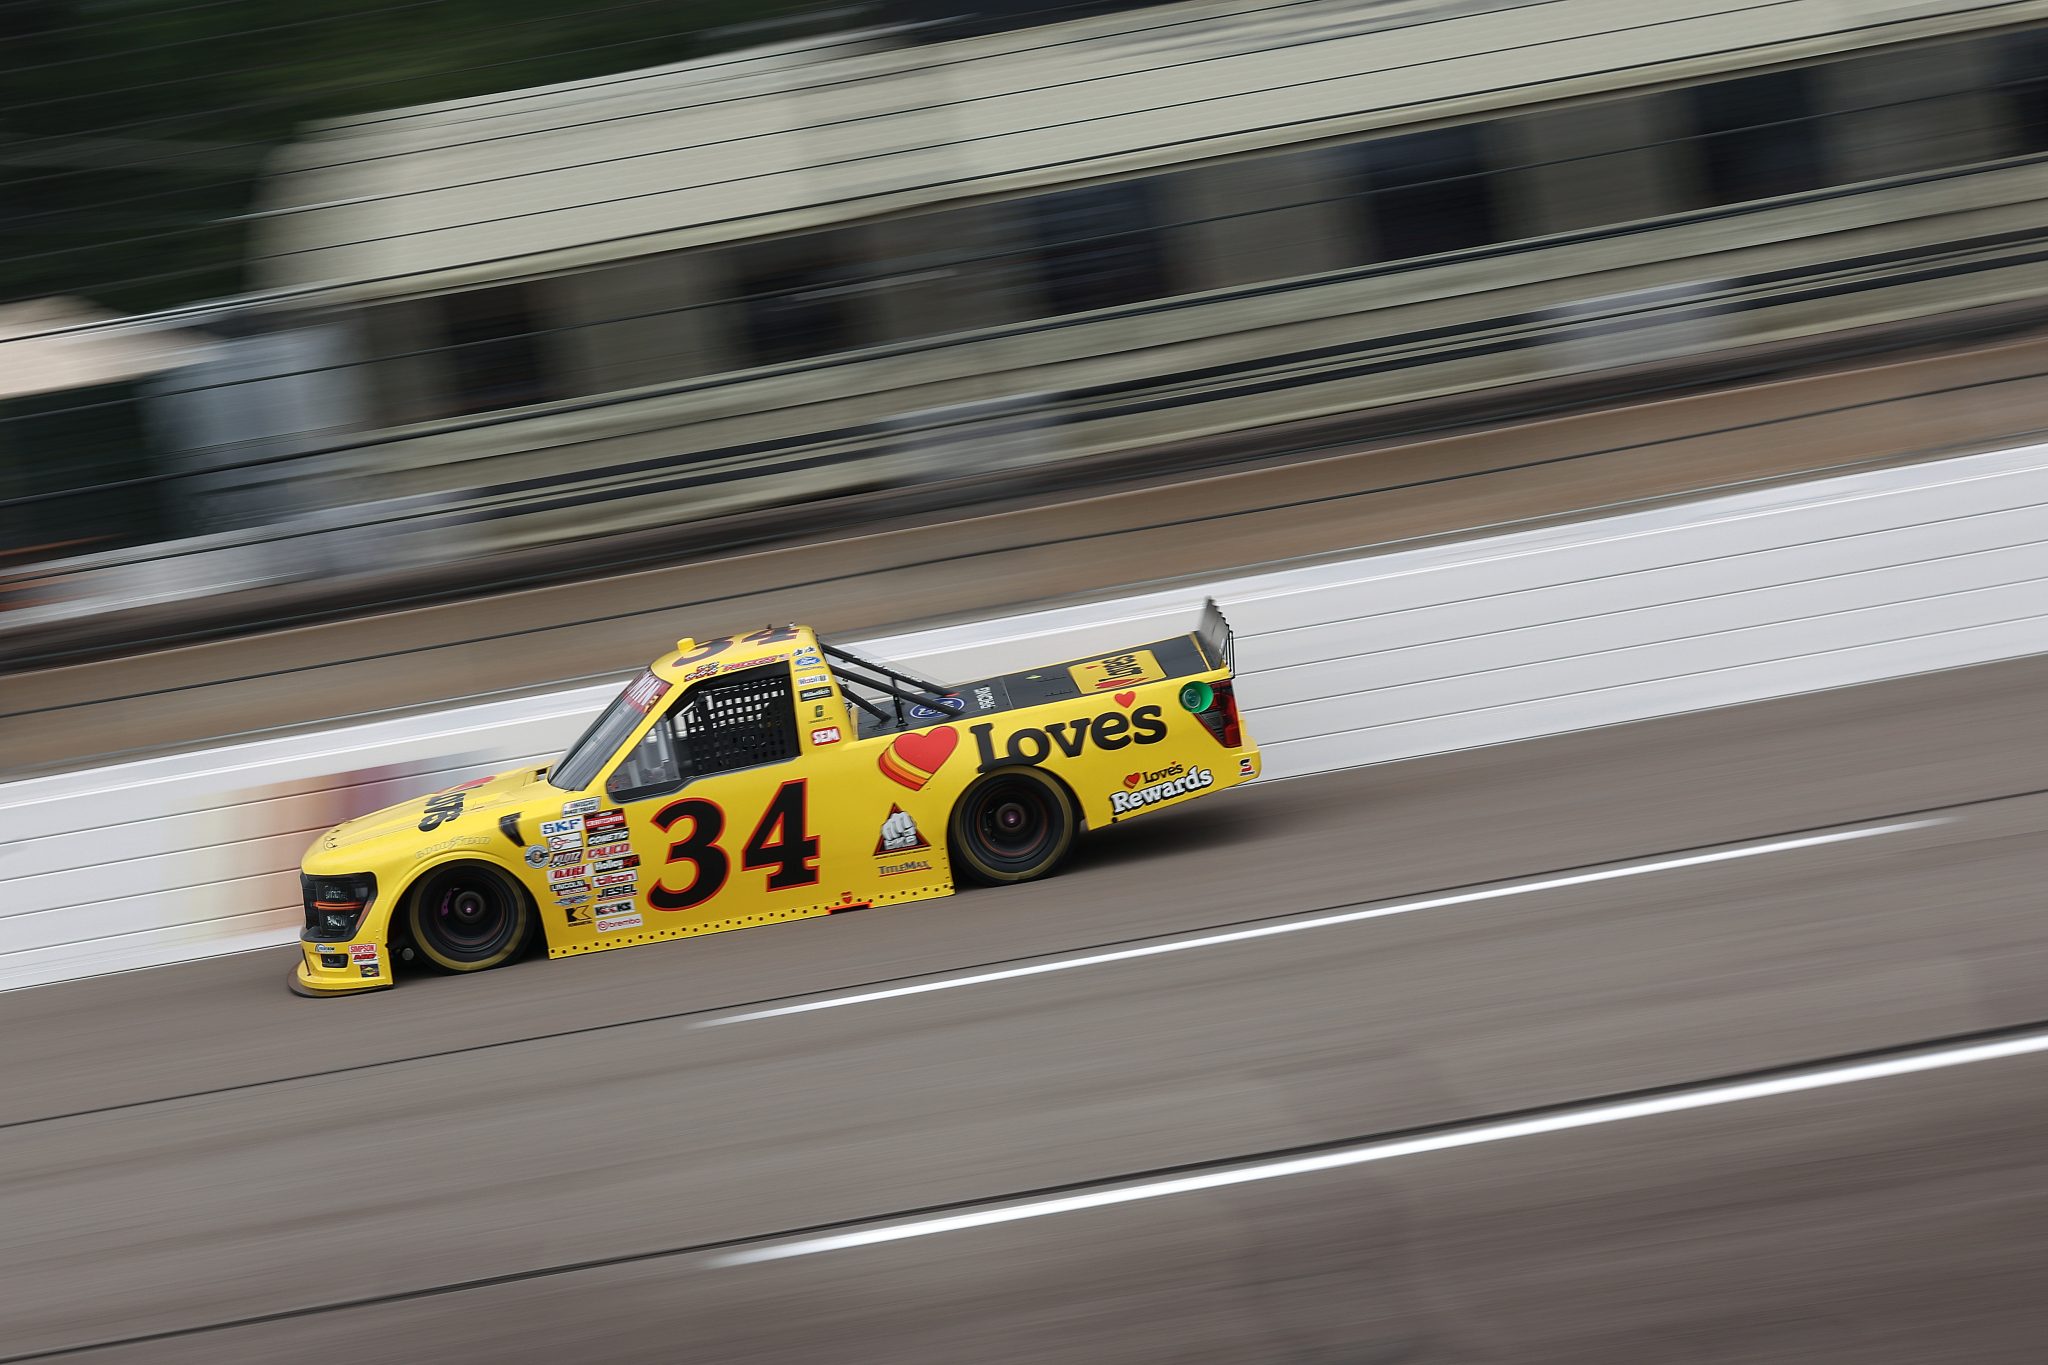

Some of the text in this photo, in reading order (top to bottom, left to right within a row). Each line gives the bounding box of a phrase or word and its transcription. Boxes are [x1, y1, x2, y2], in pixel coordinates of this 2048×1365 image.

[813, 728, 840, 744] SEM
[1110, 765, 1214, 815] Rewards
[543, 818, 581, 835] SKF
[588, 831, 629, 845] COMETIC
[647, 778, 821, 912] 34
[587, 843, 630, 859] CALICO
[551, 880, 584, 892] LINCOLN
[597, 884, 636, 897] JESEL
[609, 918, 640, 928] brembo
[350, 944, 375, 953] SIMPSON
